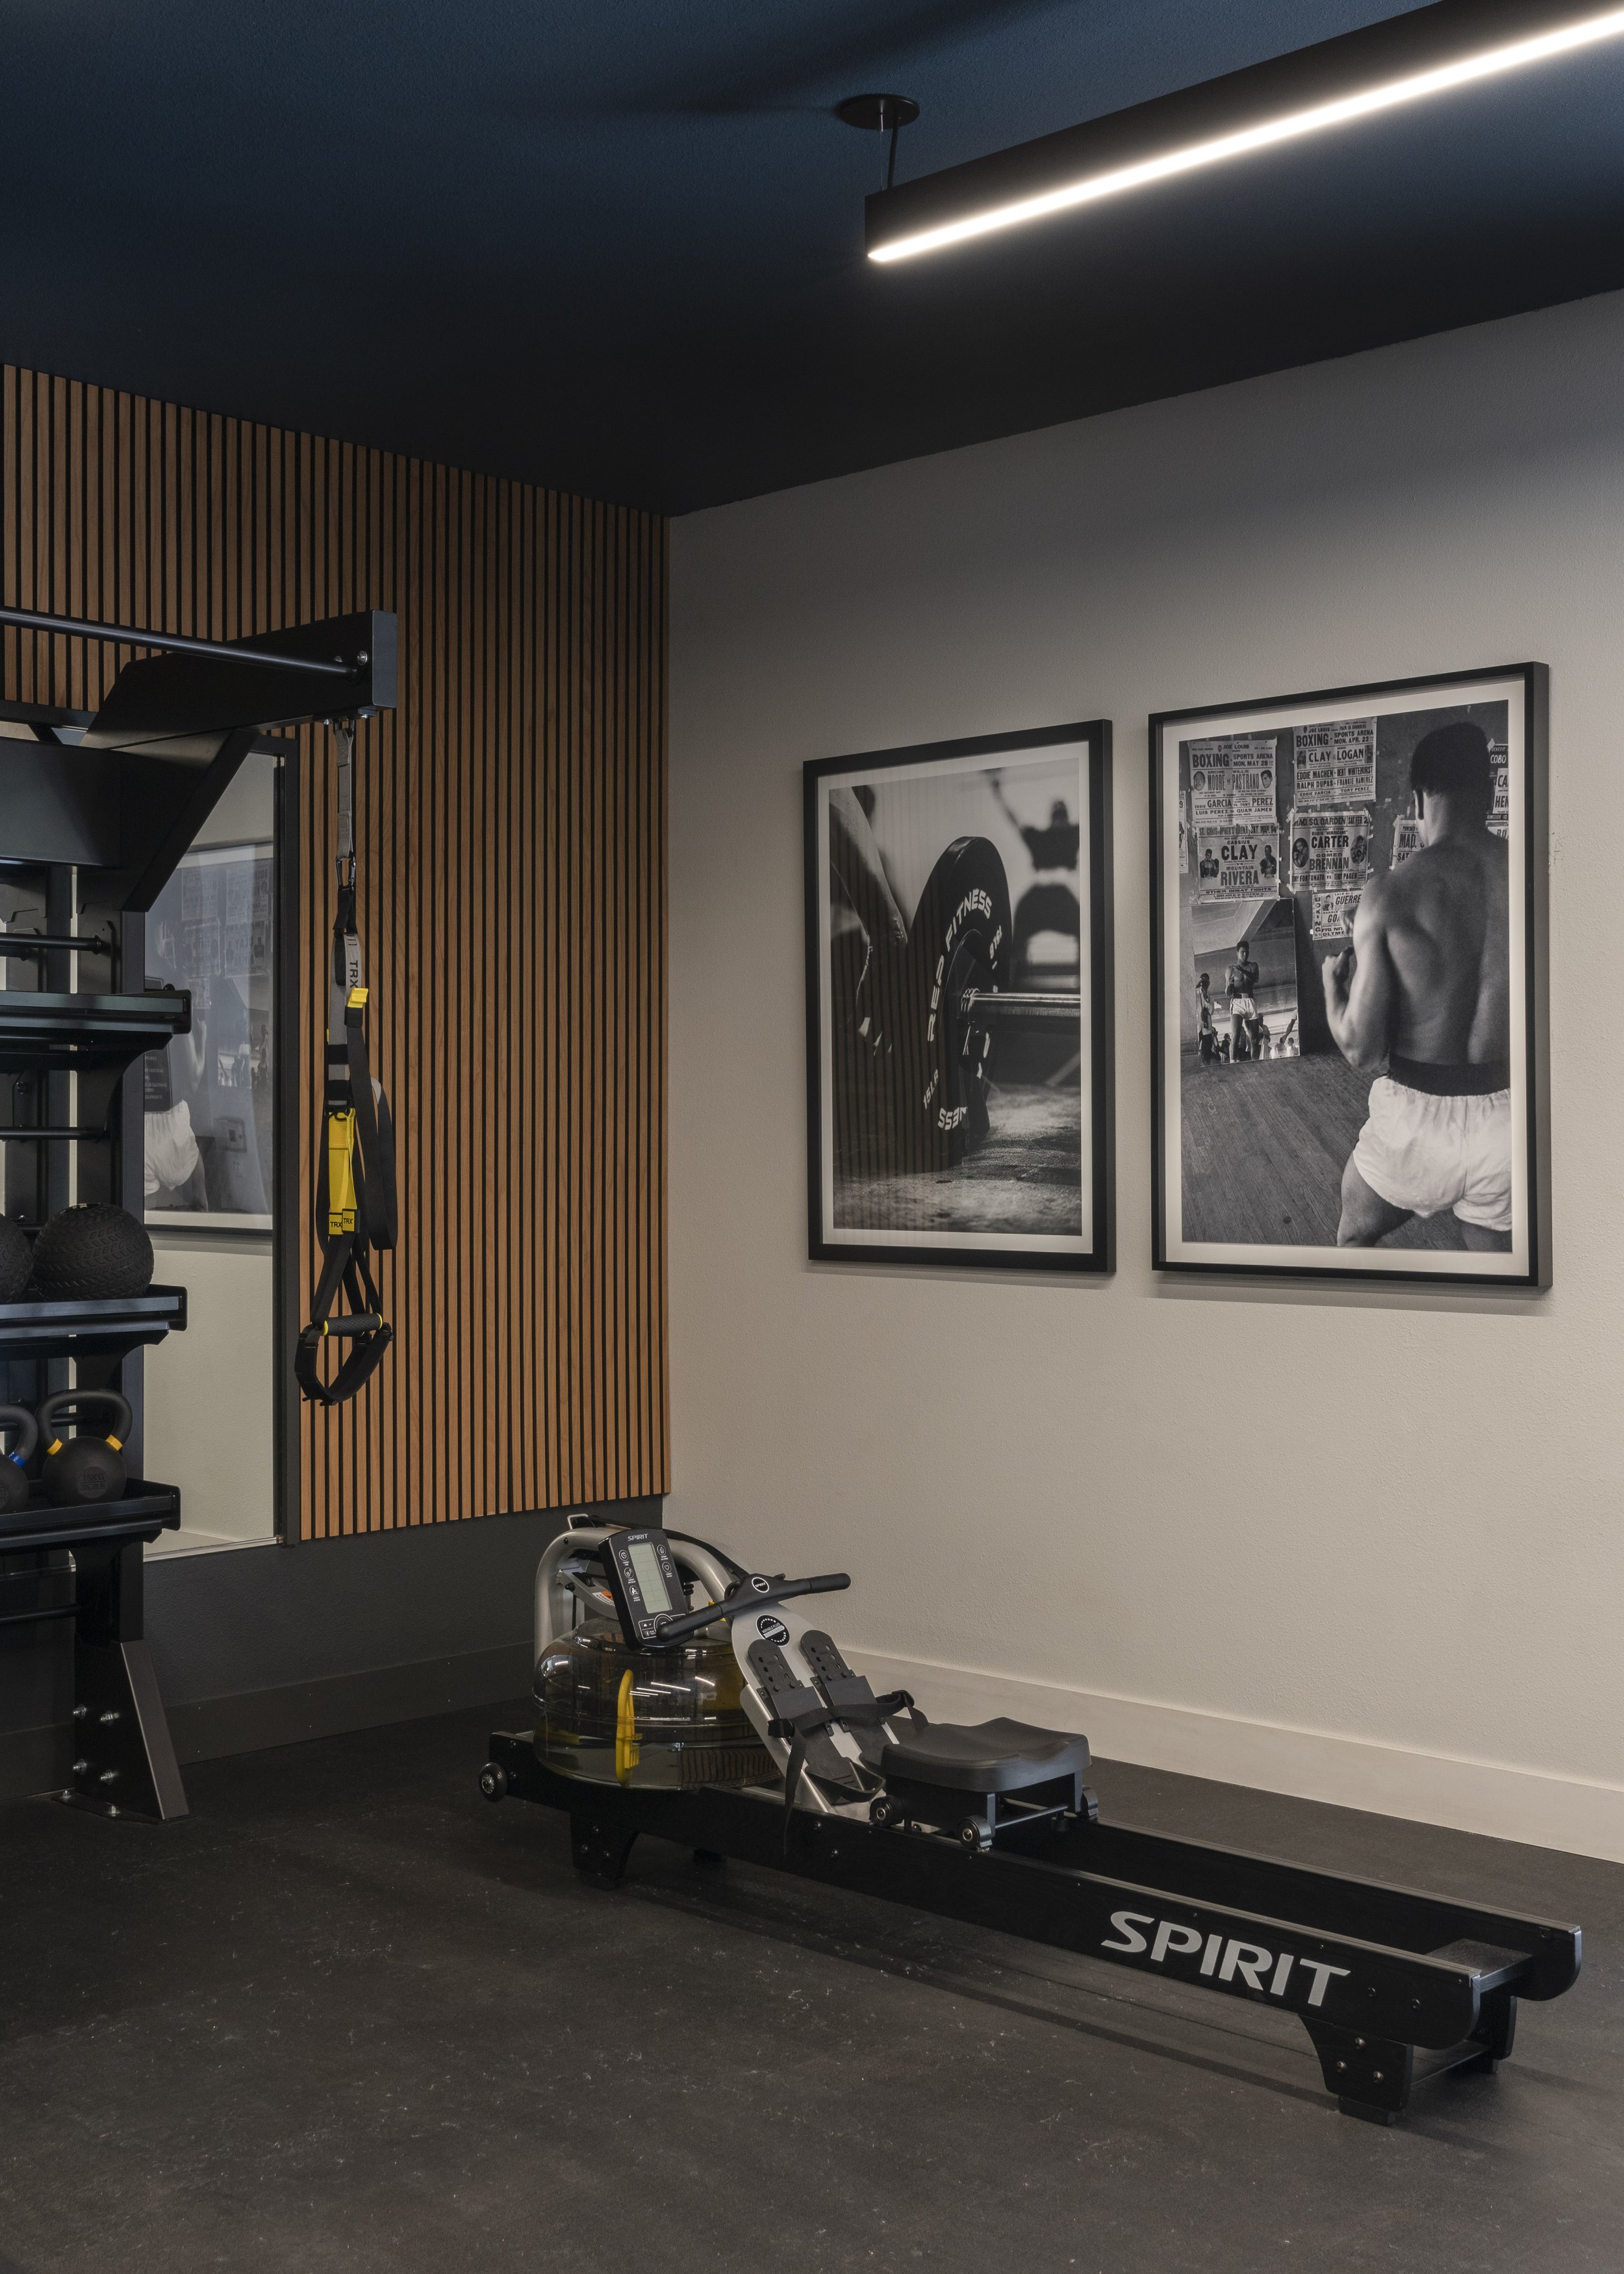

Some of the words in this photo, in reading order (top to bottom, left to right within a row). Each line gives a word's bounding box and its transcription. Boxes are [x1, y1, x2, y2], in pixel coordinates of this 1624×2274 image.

[1297, 733, 1328, 747] BOXING
[1193, 754, 1230, 767] BOXING
[1308, 751, 1331, 762] CLAY
[1337, 748, 1364, 760] LOGAN
[1490, 754, 1506, 763] COBO
[1297, 771, 1311, 780] EDDIE
[1312, 769, 1334, 779] MACHEN
[1208, 774, 1225, 791] MOORE
[1232, 773, 1259, 790] PASTRANO
[1297, 781, 1314, 789] RALPH
[1207, 798, 1232, 808] GARCIA
[1252, 797, 1273, 806] PEREZ
[1320, 817, 1346, 825] GARDEN
[1312, 836, 1349, 849] CARTER
[1221, 844, 1258, 860] CLAY
[1309, 857, 1349, 870] BRENNAN
[1221, 870, 1259, 886] RIVERA
[945, 888, 993, 952] FITNESS
[349, 960, 358, 988] TRX
[1100, 1911, 1351, 2006] SPIRIT
